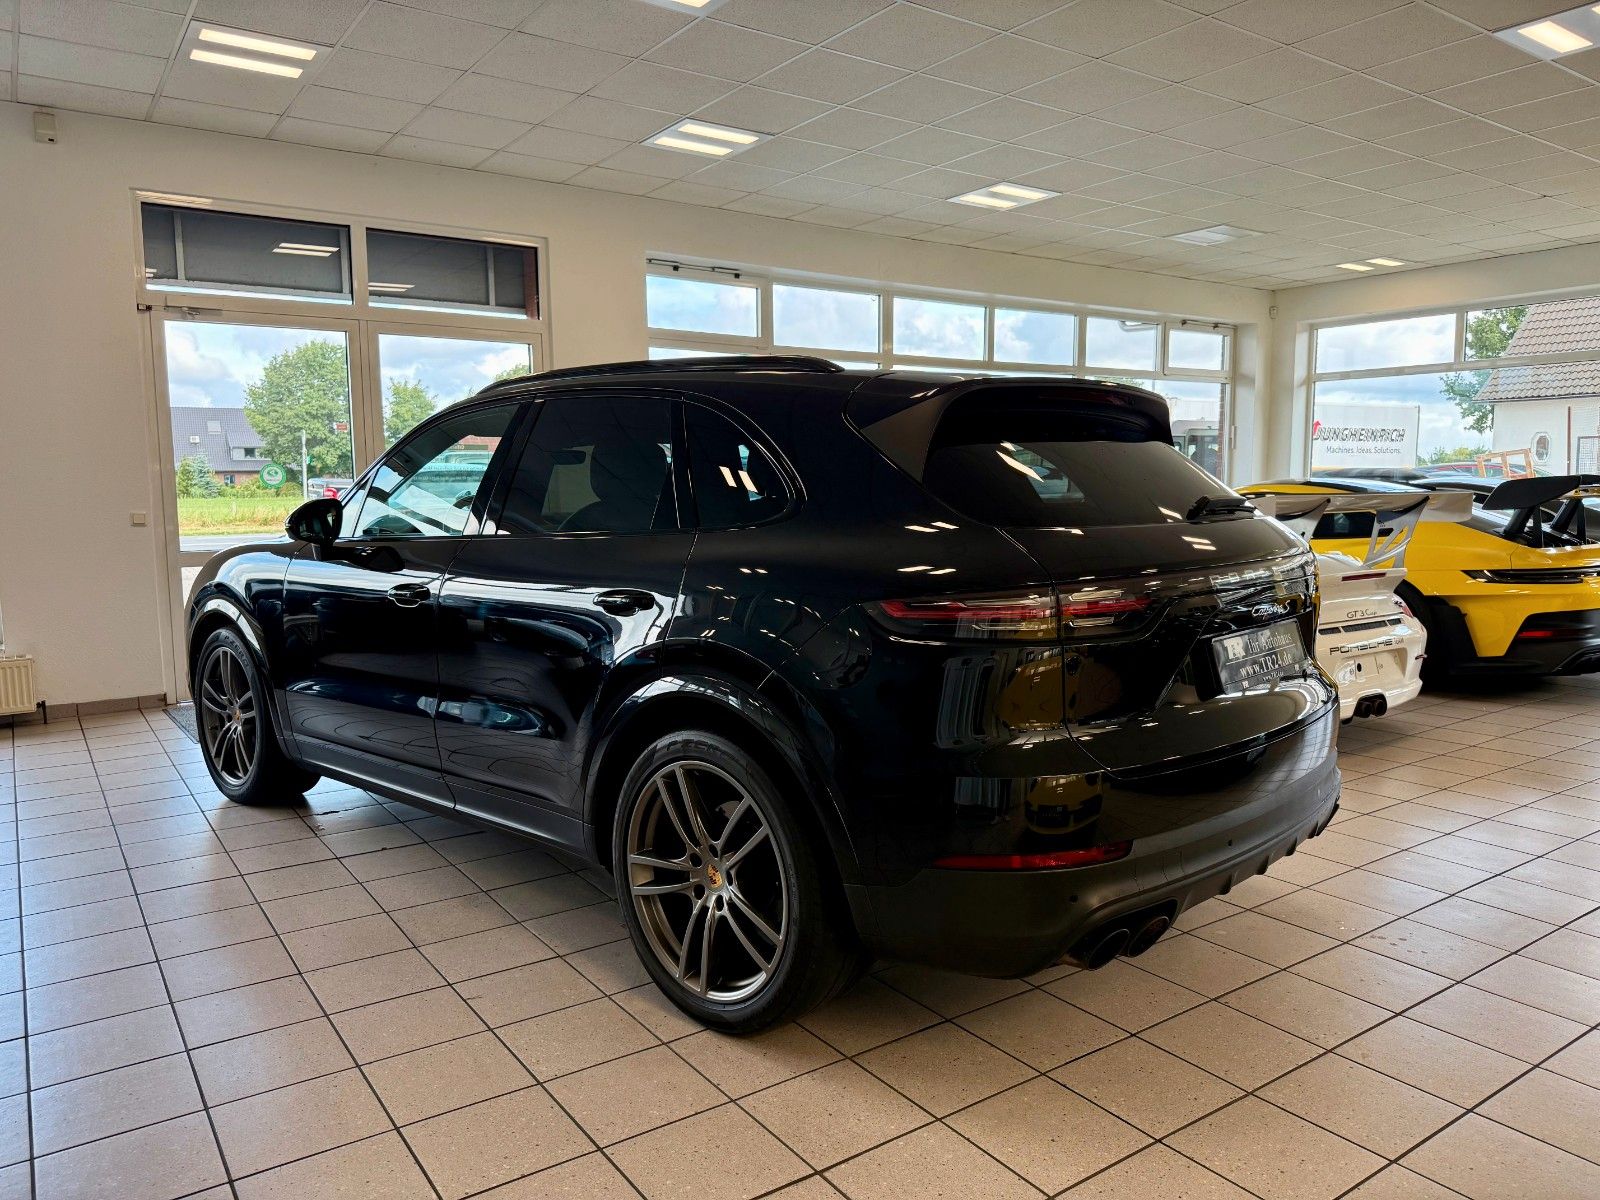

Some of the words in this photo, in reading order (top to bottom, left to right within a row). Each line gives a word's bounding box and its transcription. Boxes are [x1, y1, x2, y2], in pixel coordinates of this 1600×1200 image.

[1312, 421, 1406, 442] JUNGHEINRICH
[1329, 638, 1393, 656] PORSCHE
[1239, 651, 1293, 678] www.TR24.de
